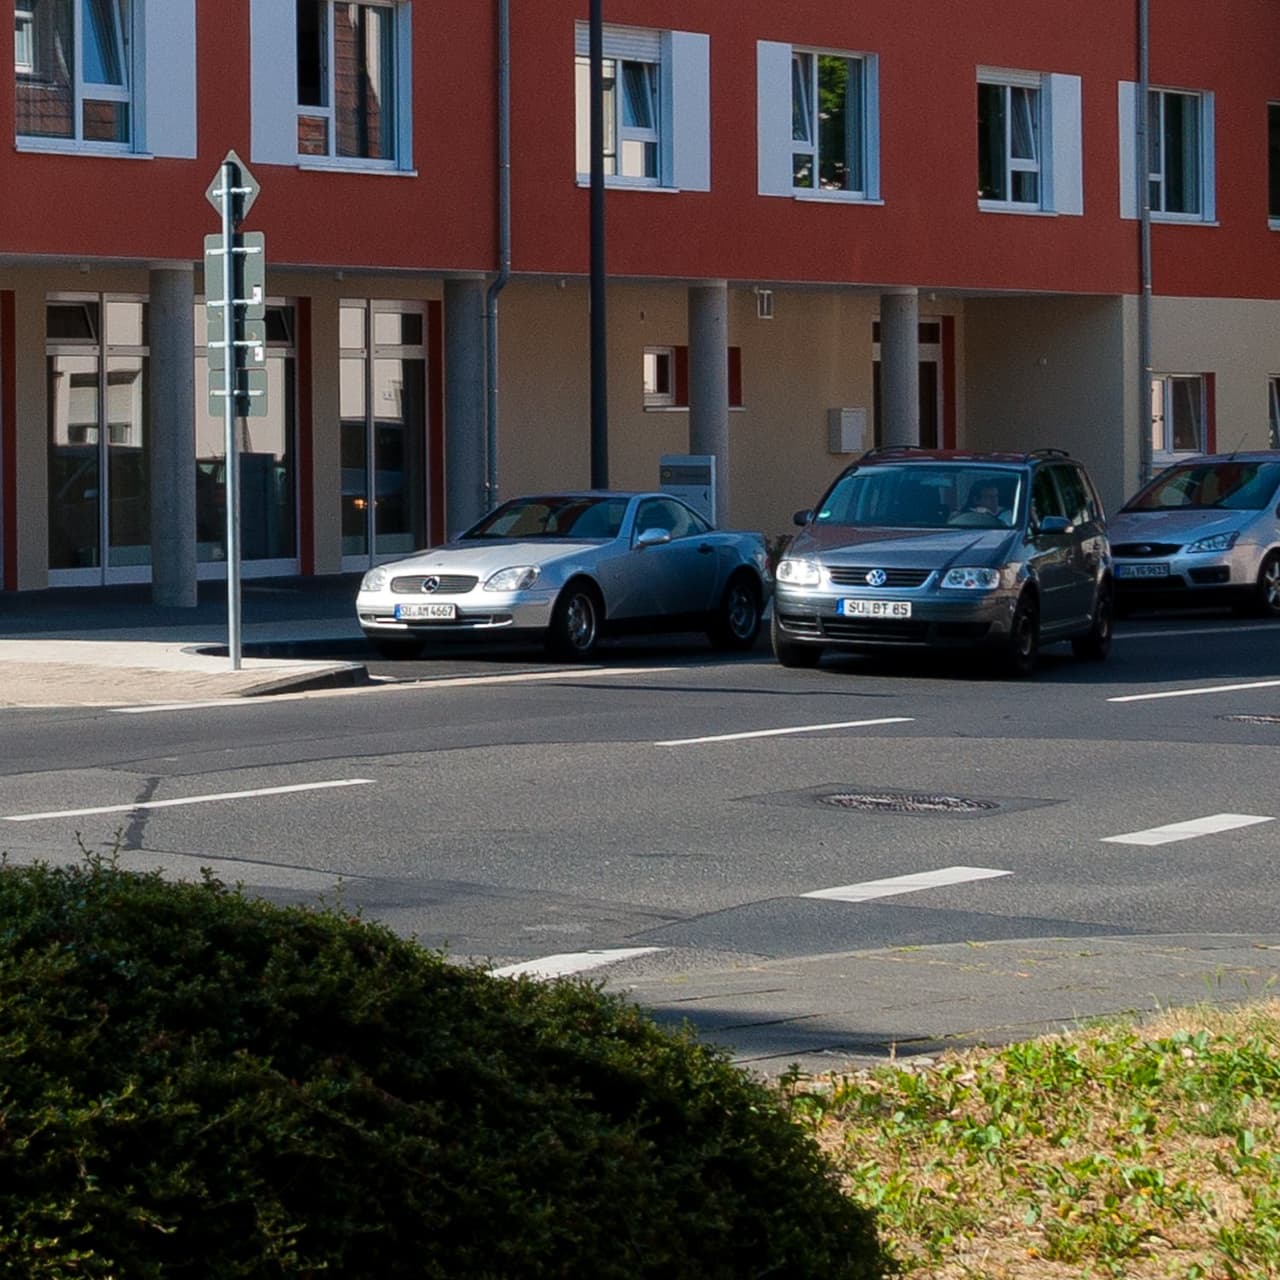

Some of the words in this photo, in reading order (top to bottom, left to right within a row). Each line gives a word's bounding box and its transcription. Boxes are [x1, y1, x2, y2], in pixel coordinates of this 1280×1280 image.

[401, 606, 412, 616] SU
[849, 601, 865, 613] SU
[872, 602, 889, 615] BT
